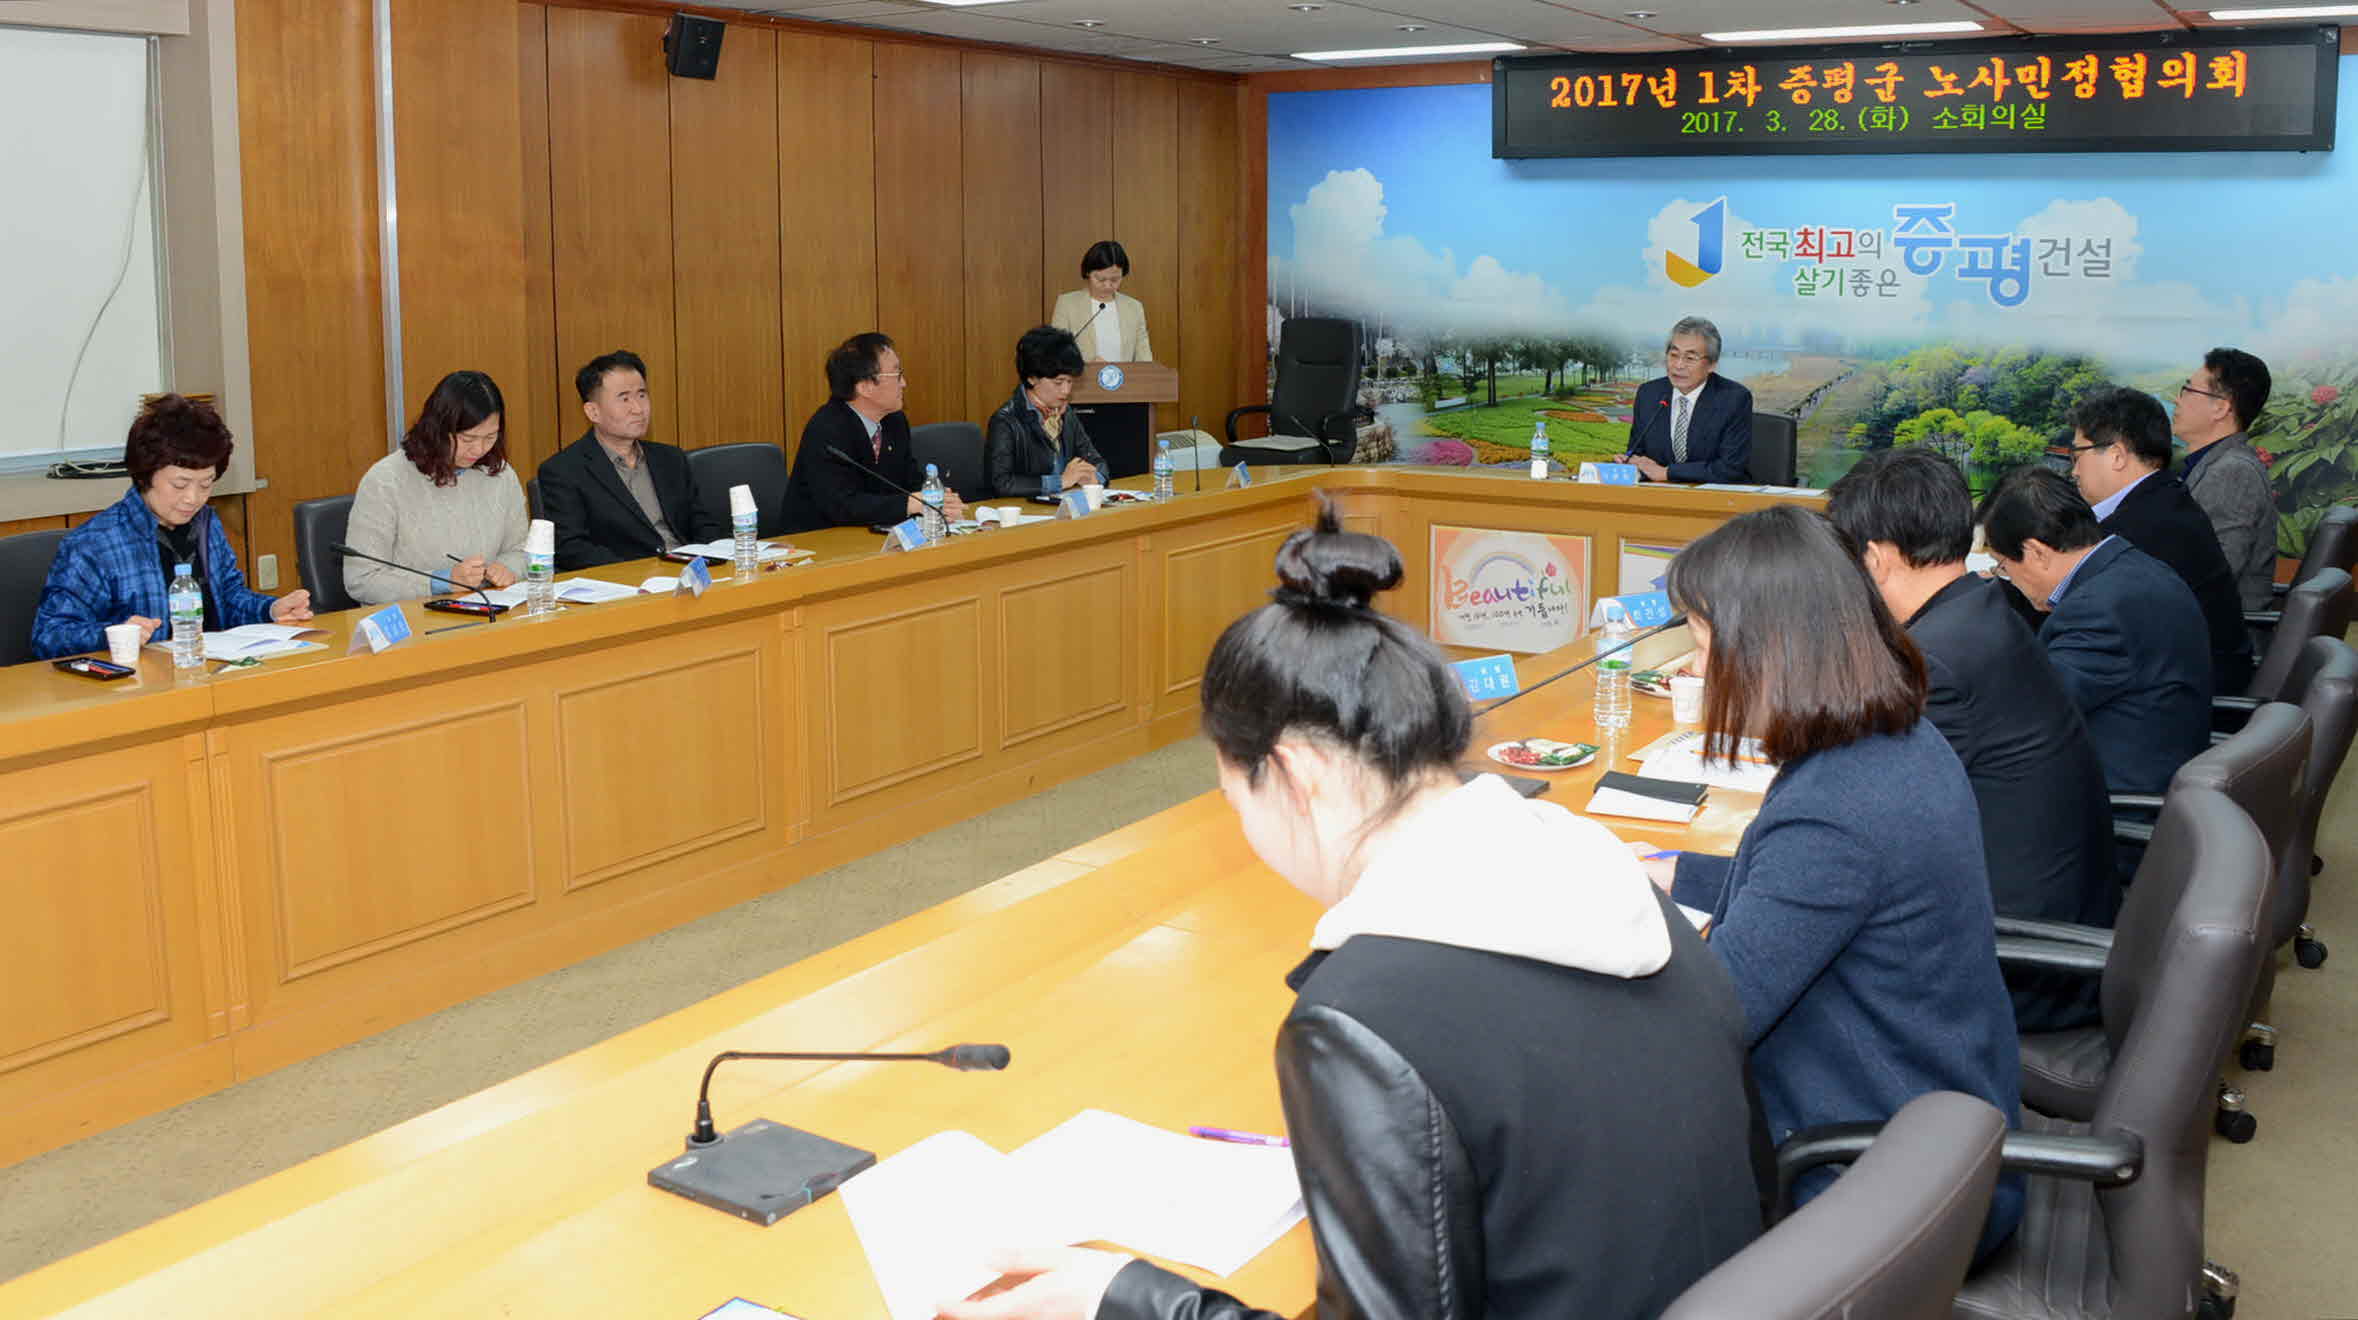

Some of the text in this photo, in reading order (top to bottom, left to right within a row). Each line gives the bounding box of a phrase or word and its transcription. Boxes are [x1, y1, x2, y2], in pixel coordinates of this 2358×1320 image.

[1550, 50, 2248, 109] 2017년 1차 증평군 노사민정협의회
[1681, 111, 1744, 133] 2017.
[1765, 110, 1787, 132] 3.
[1932, 103, 2048, 130] 소회의실
[2038, 236, 2112, 278] 건설
[1442, 563, 1571, 611] Beautiful
